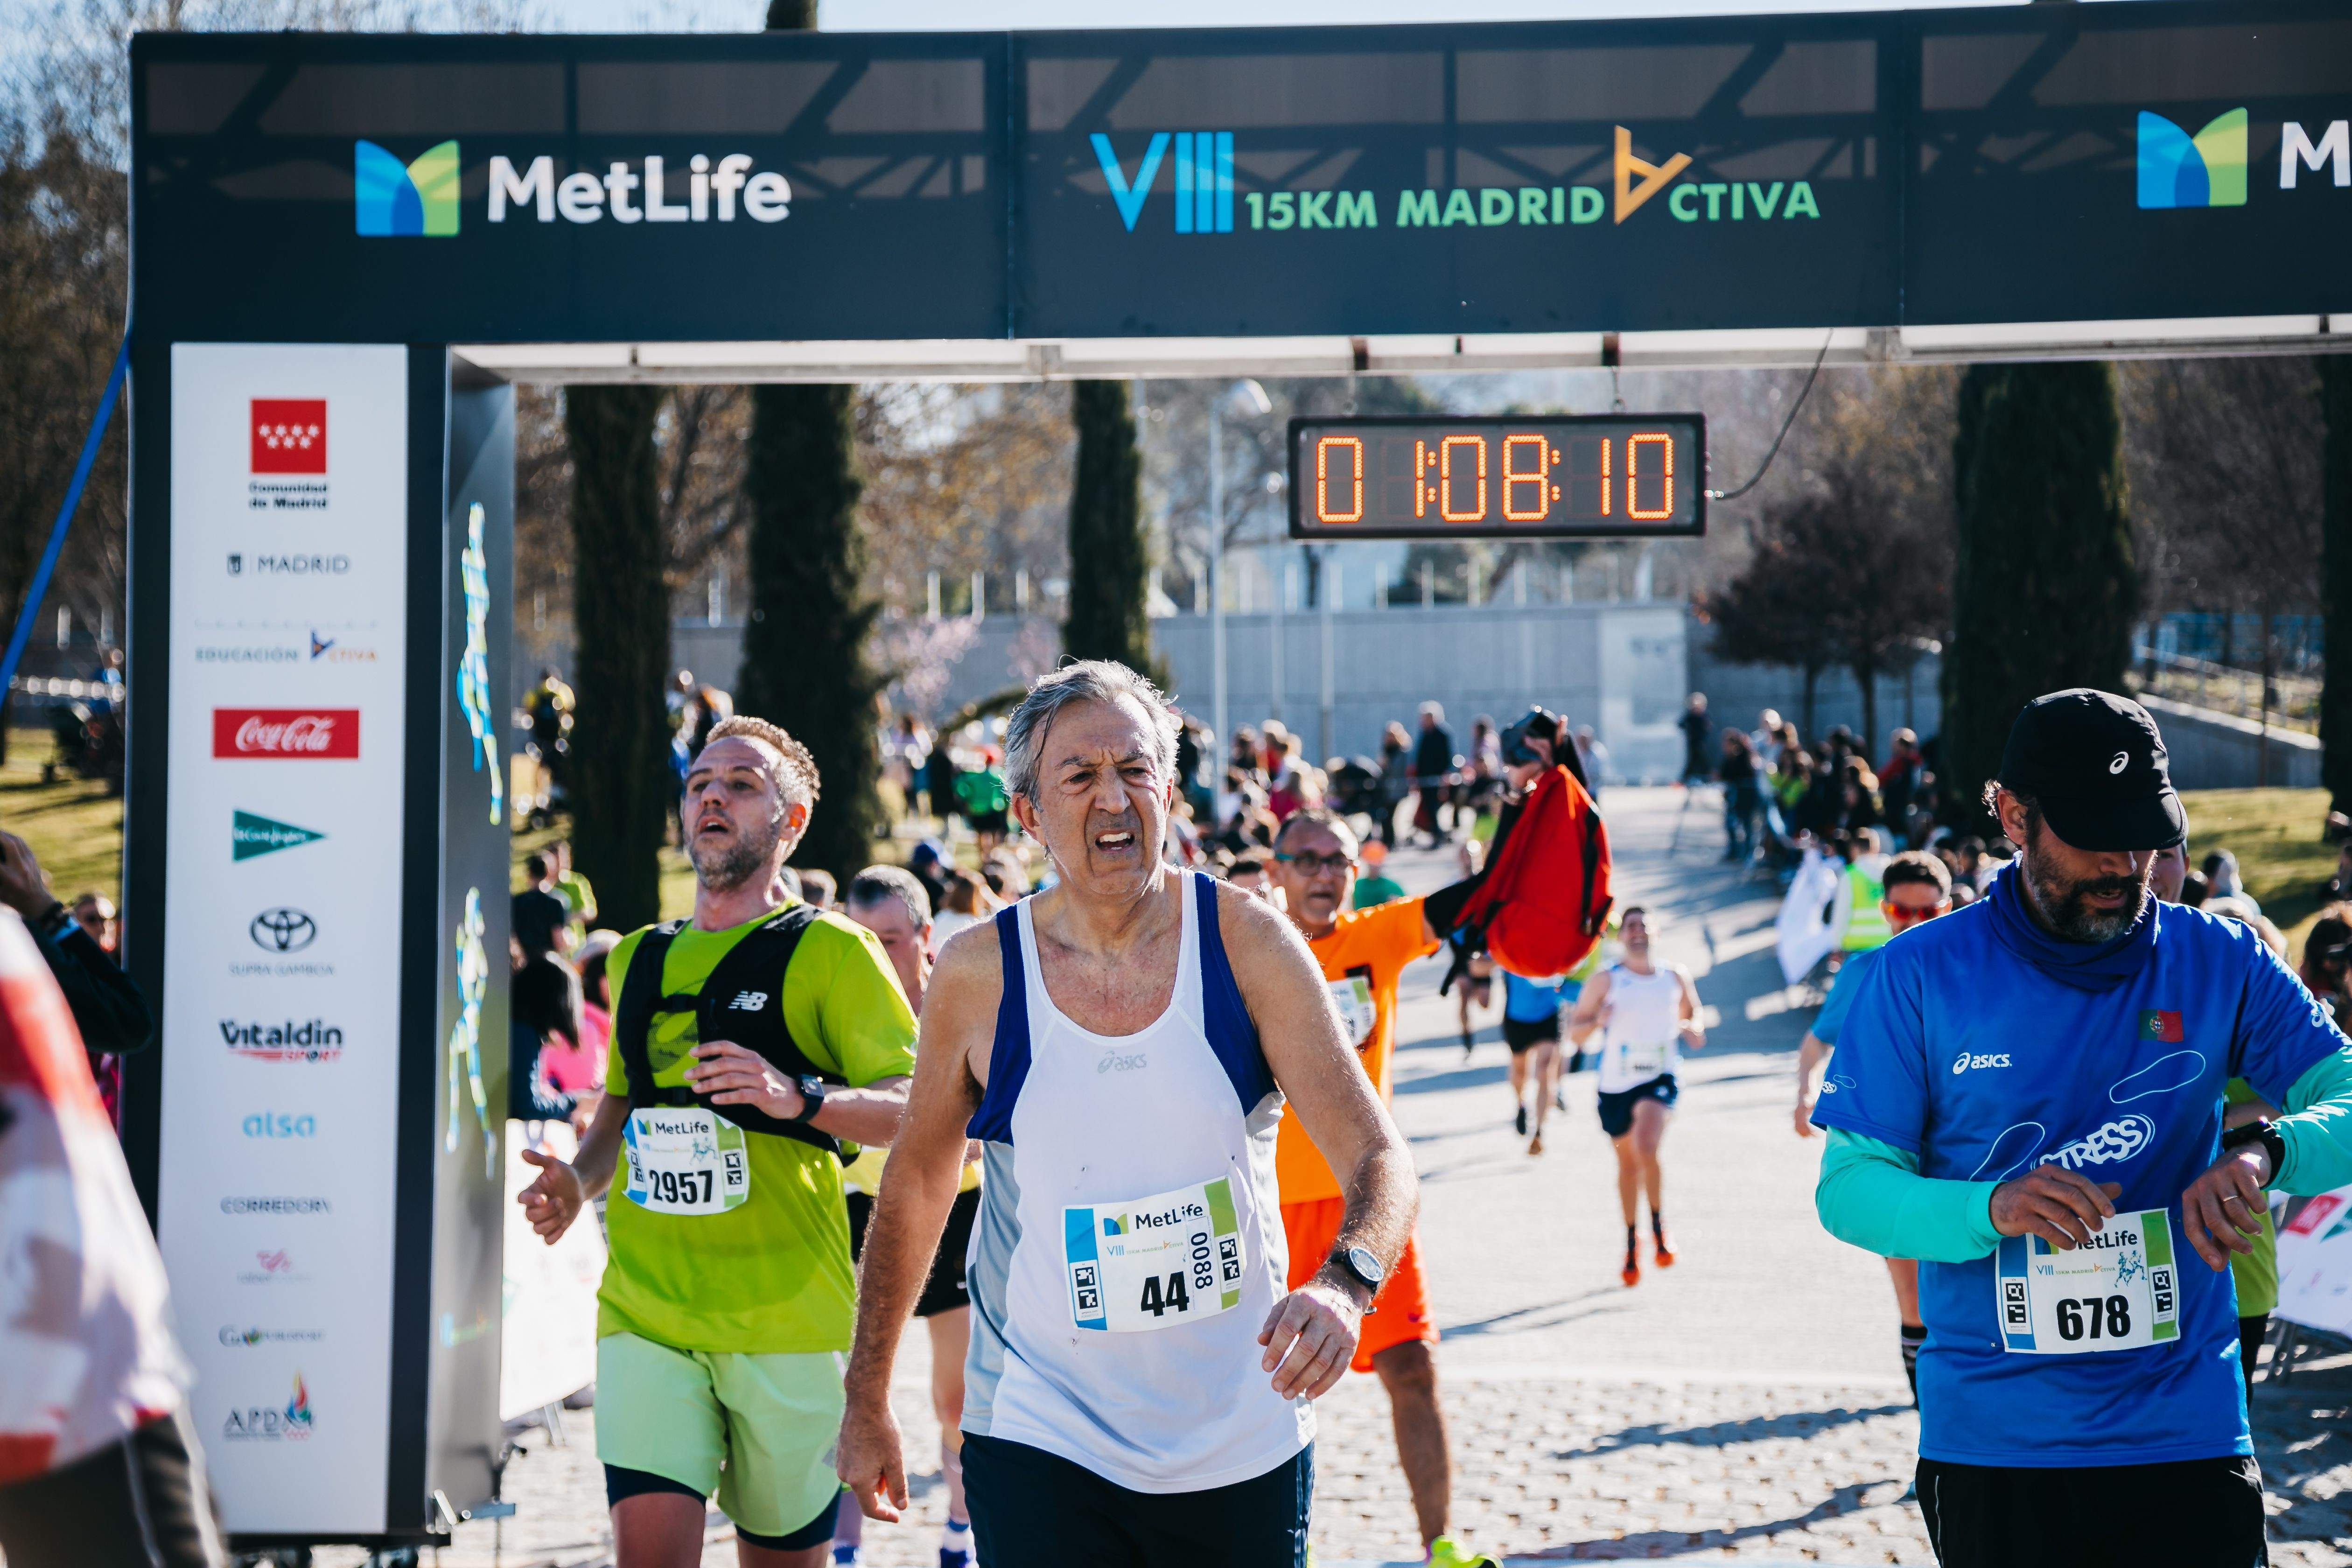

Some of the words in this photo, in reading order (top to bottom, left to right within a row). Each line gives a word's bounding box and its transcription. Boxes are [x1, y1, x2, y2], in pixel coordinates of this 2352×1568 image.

[488, 153, 791, 223] MetLife
[1090, 131, 1234, 232] VIII
[1245, 190, 1378, 229] 15KM
[1396, 186, 1604, 226] MADRID
[249, 498, 266, 508] de
[273, 498, 329, 508] Madrid
[258, 554, 350, 574] MADRID
[195, 646, 299, 662] EDUCACIÓN
[219, 1019, 343, 1047] Vitaldin
[242, 1111, 316, 1138] alsa
[655, 1121, 709, 1135] MetLife
[649, 1169, 713, 1204] 2957
[1135, 1204, 1203, 1229] MetLife
[1106, 1245, 1125, 1256] VIII
[2077, 1230, 2138, 1250] etLife
[1190, 1232, 1213, 1289] 0088
[2036, 1264, 2054, 1275] VIII
[1141, 1271, 1190, 1317] 44
[2056, 1295, 2131, 1341] 678
